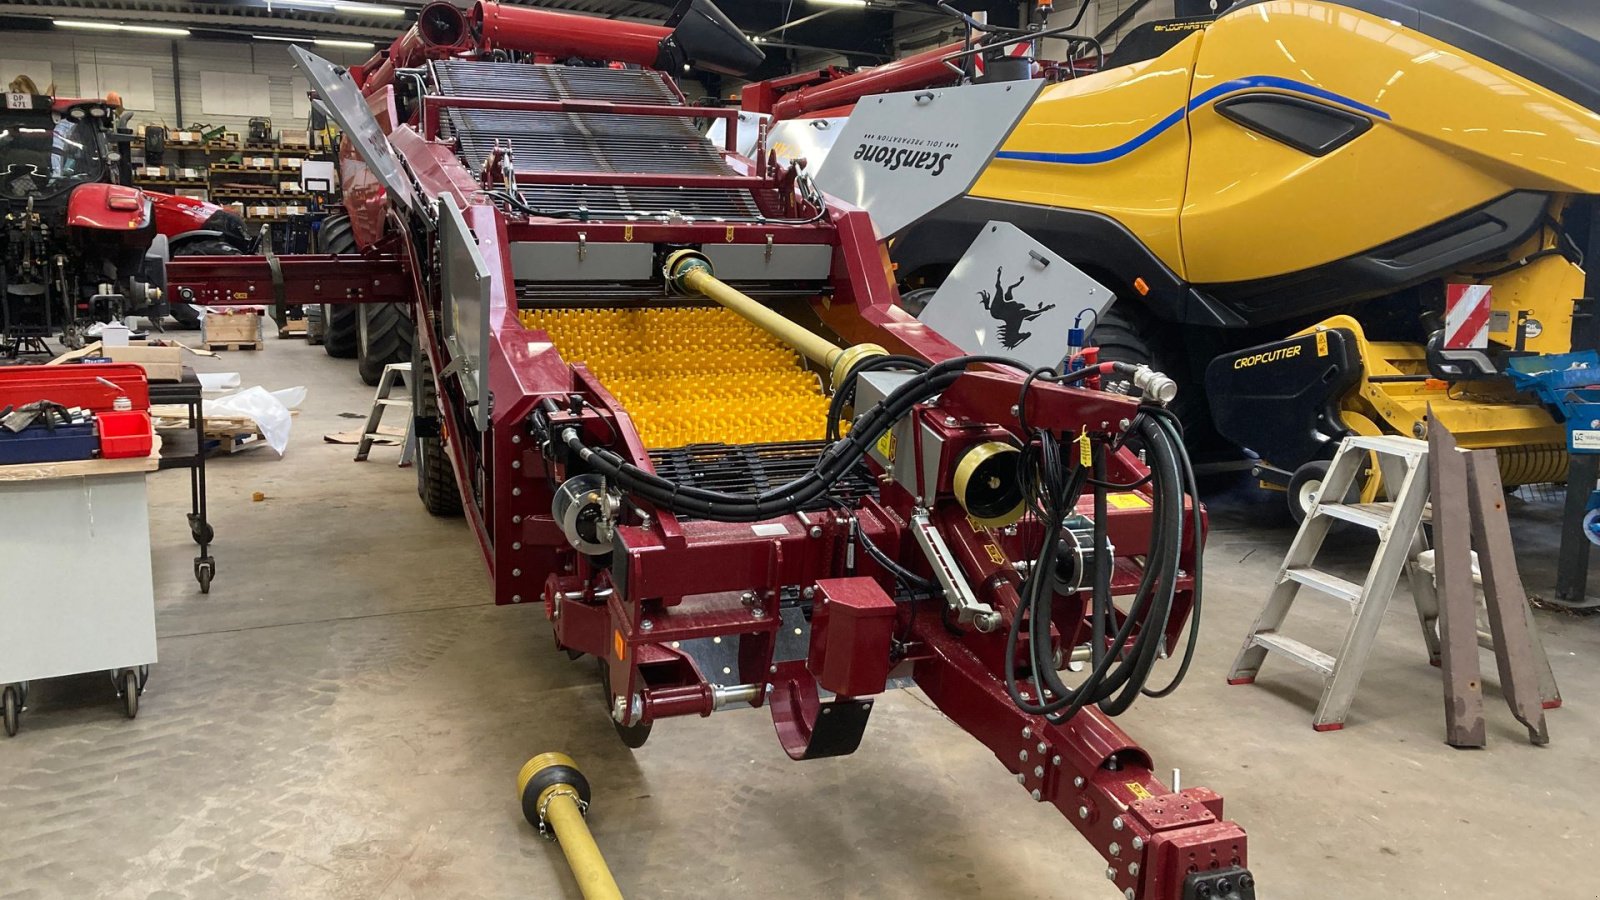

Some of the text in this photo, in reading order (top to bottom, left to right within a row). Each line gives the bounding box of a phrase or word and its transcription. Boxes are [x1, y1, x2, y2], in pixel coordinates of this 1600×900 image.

[876, 134, 944, 148] SOIL PREPARATION
[1234, 344, 1302, 370] CROPCUTTER
